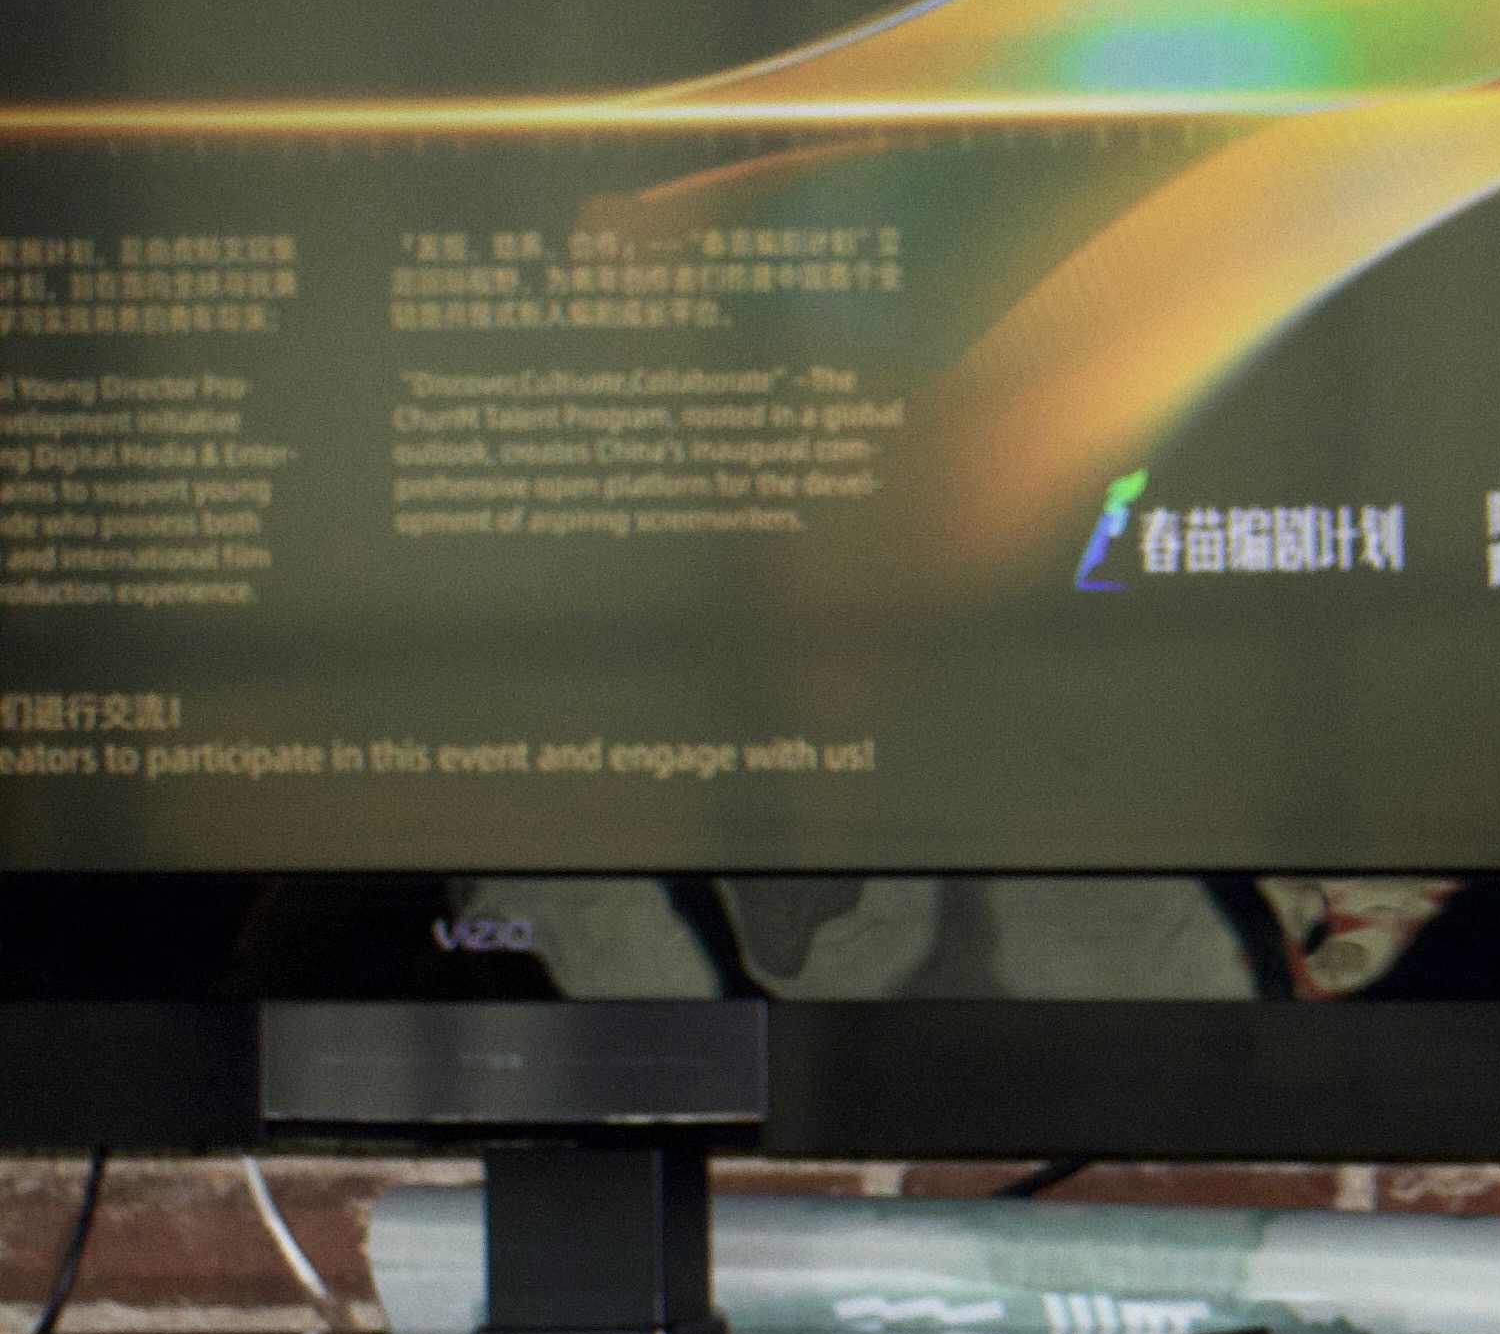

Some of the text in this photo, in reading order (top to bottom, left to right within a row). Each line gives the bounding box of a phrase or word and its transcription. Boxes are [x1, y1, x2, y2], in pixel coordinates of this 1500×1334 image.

[1140, 505, 1404, 573] 春苗编剧计划
[104, 743, 142, 774] to
[147, 741, 327, 779] participate
[331, 739, 365, 772] in
[369, 739, 432, 773] this
[437, 741, 530, 773] event
[536, 737, 603, 773] and
[608, 743, 738, 780] engage
[744, 737, 819, 771] with
